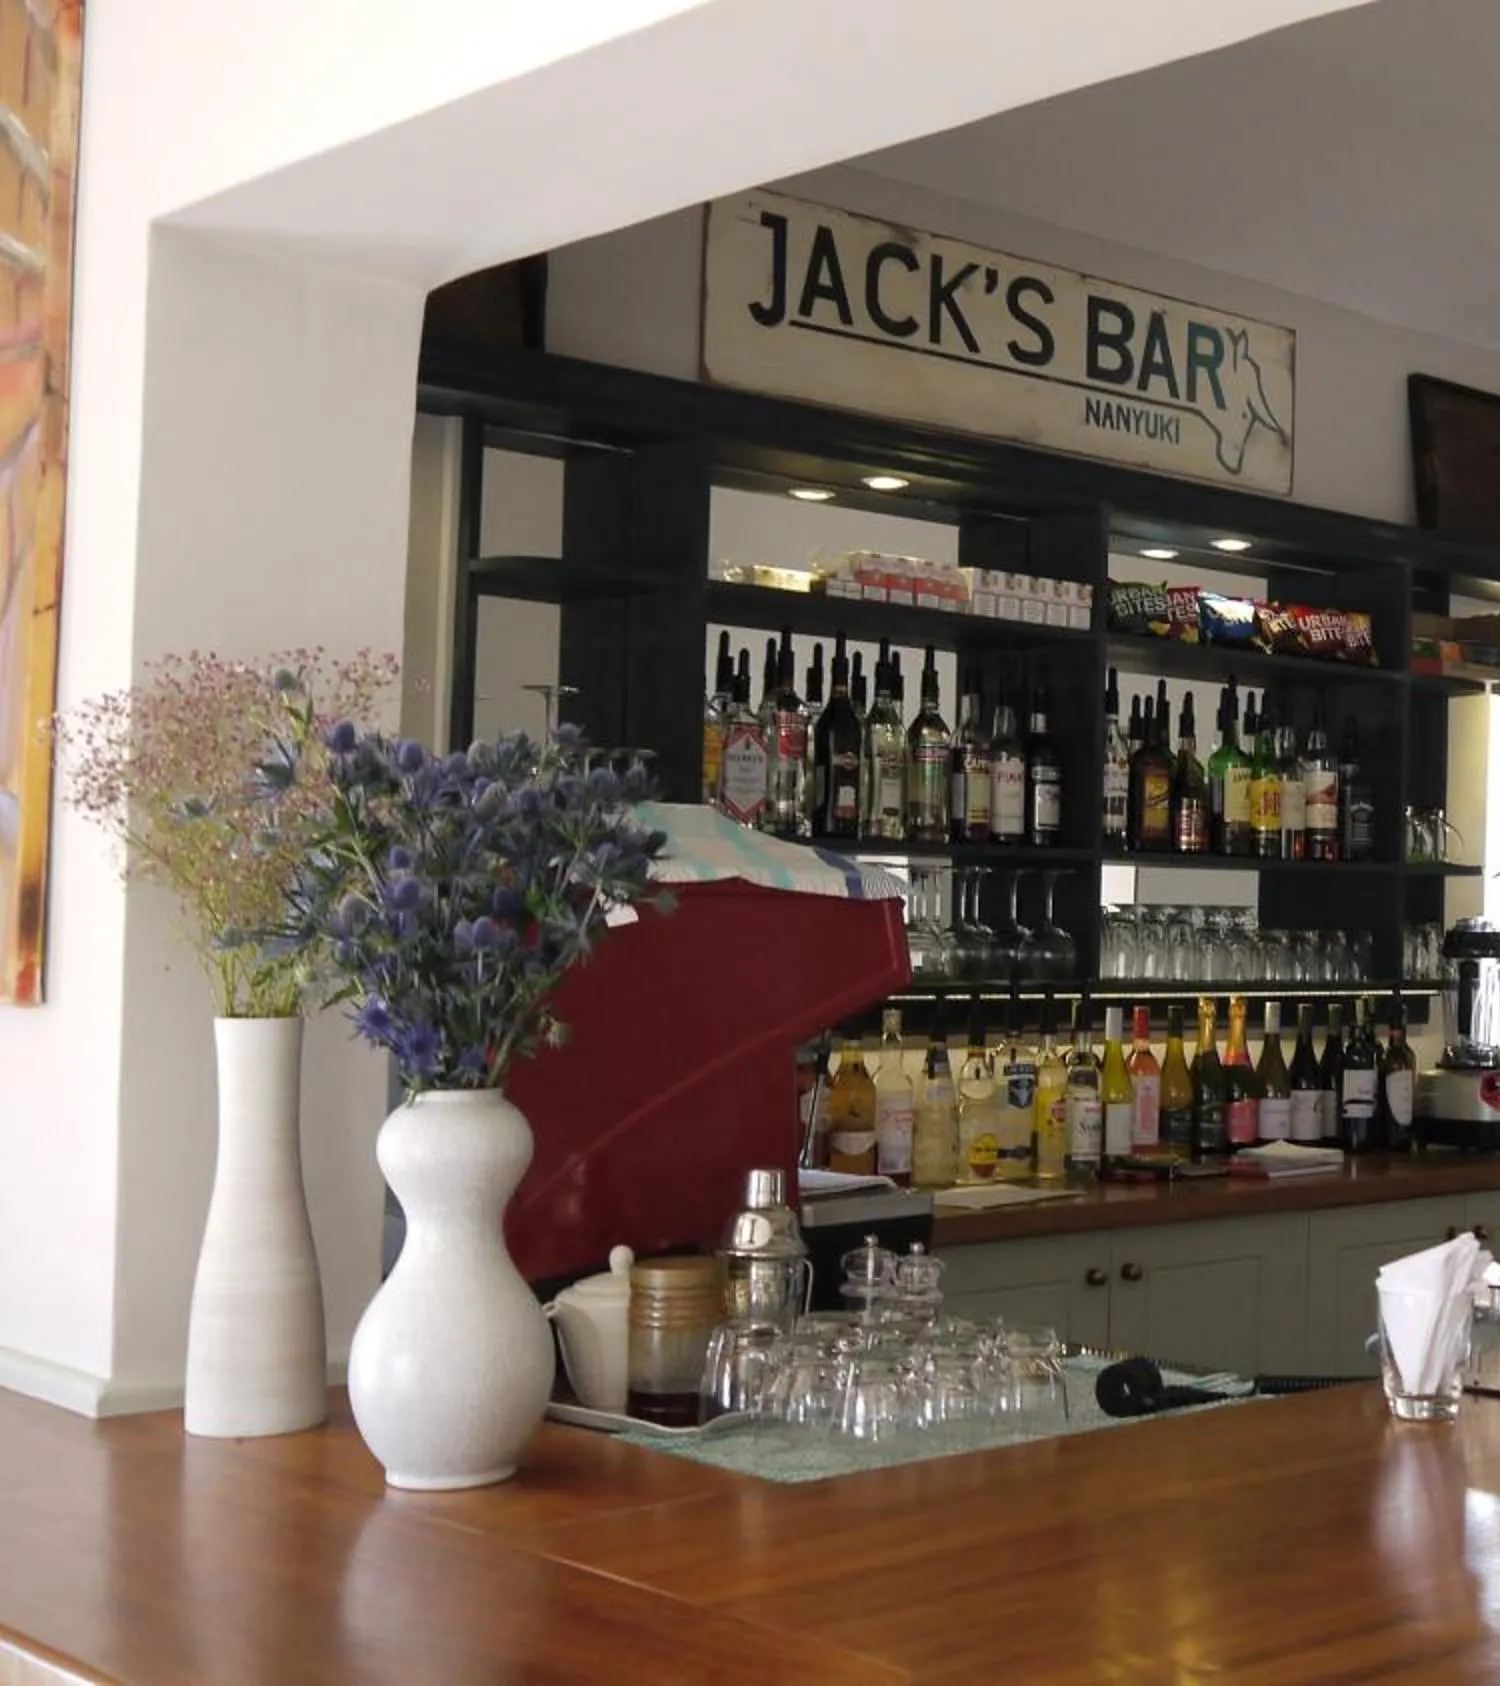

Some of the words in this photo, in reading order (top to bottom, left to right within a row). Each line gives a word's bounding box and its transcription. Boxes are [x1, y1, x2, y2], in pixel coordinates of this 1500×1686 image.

[748, 211, 1055, 366] JACK'S
[1085, 294, 1226, 408] BAR
[1085, 397, 1181, 444] NANYUKI
[1311, 627, 1344, 642] BITE
